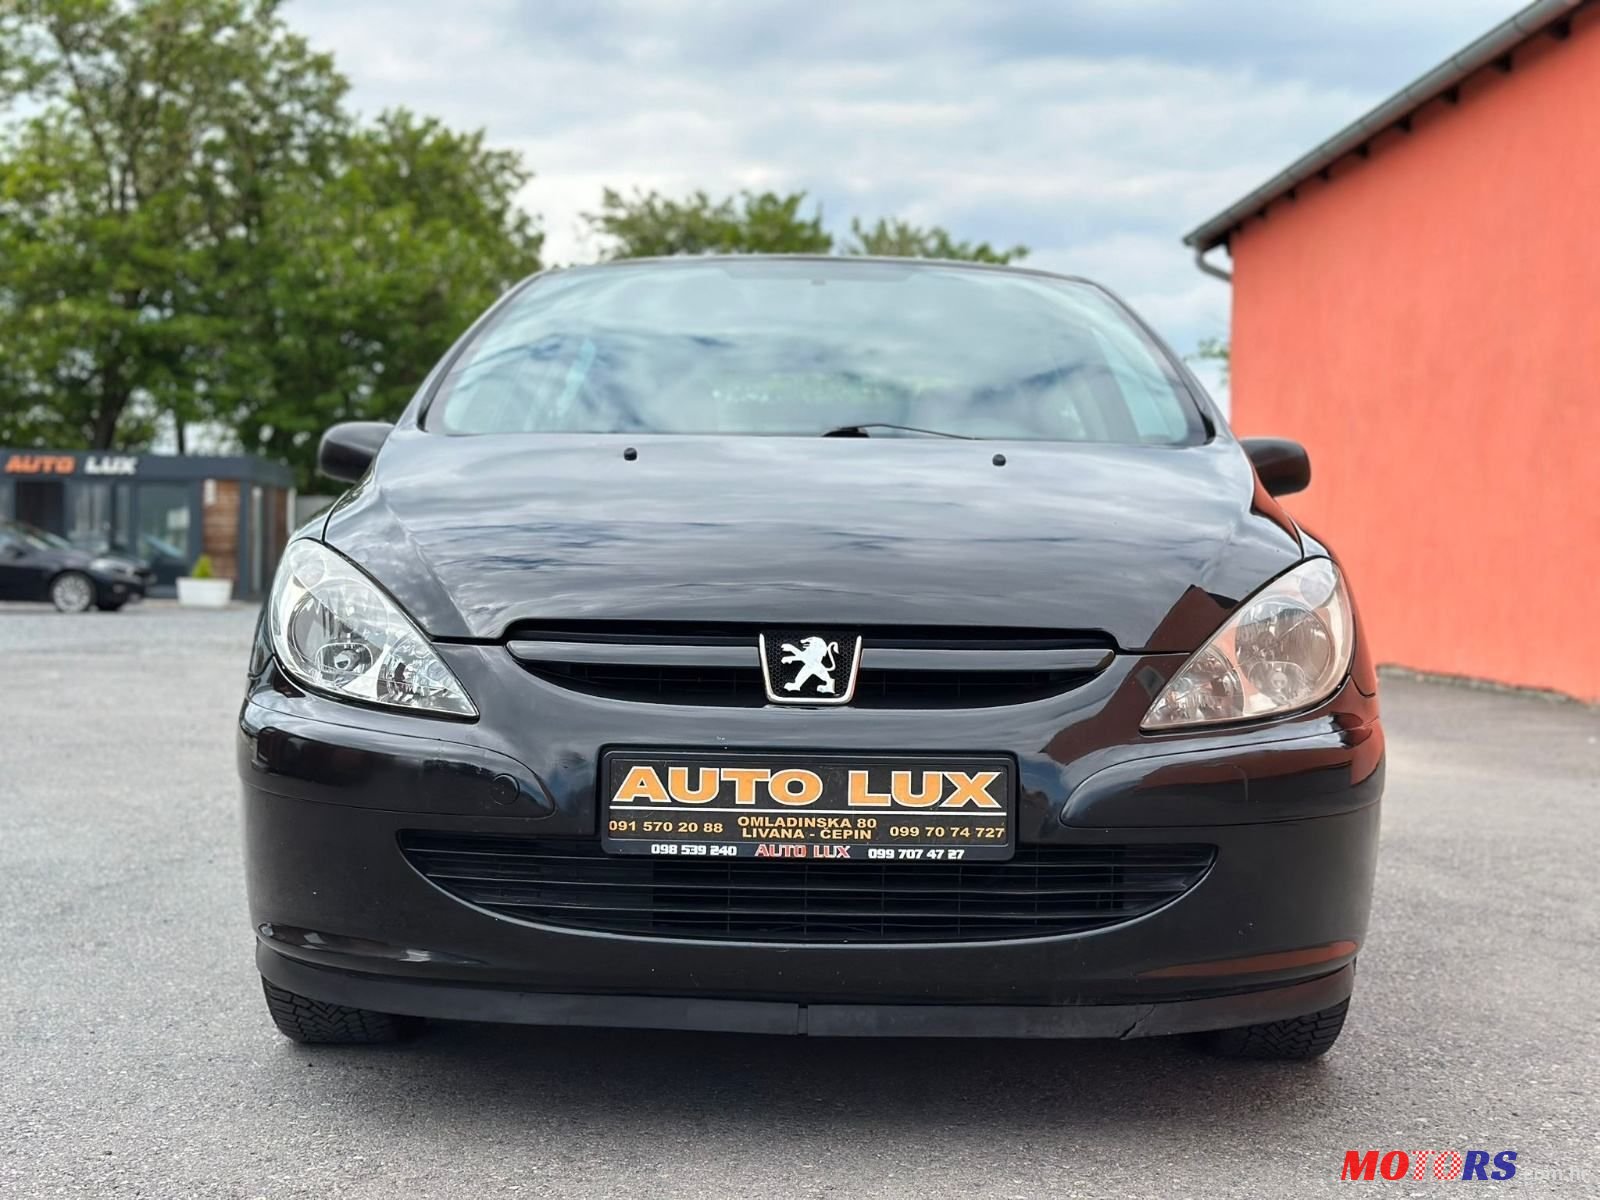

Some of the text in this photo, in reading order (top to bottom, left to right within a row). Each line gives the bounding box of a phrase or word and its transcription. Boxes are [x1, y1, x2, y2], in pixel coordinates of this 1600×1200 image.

[5, 455, 138, 475] AUTO LUX
[612, 765, 1003, 809] AUTO LUX
[609, 820, 724, 833] 091 570 20 88
[737, 816, 877, 829] OMLADINSKA 80
[742, 828, 805, 839] LIVANA
[820, 826, 872, 840] ČEPIN
[889, 826, 1005, 838] 099 70 74 727
[651, 844, 737, 857] 098 539 240
[755, 844, 851, 859] AUTO LUX
[868, 848, 965, 860] 099 707 47 27
